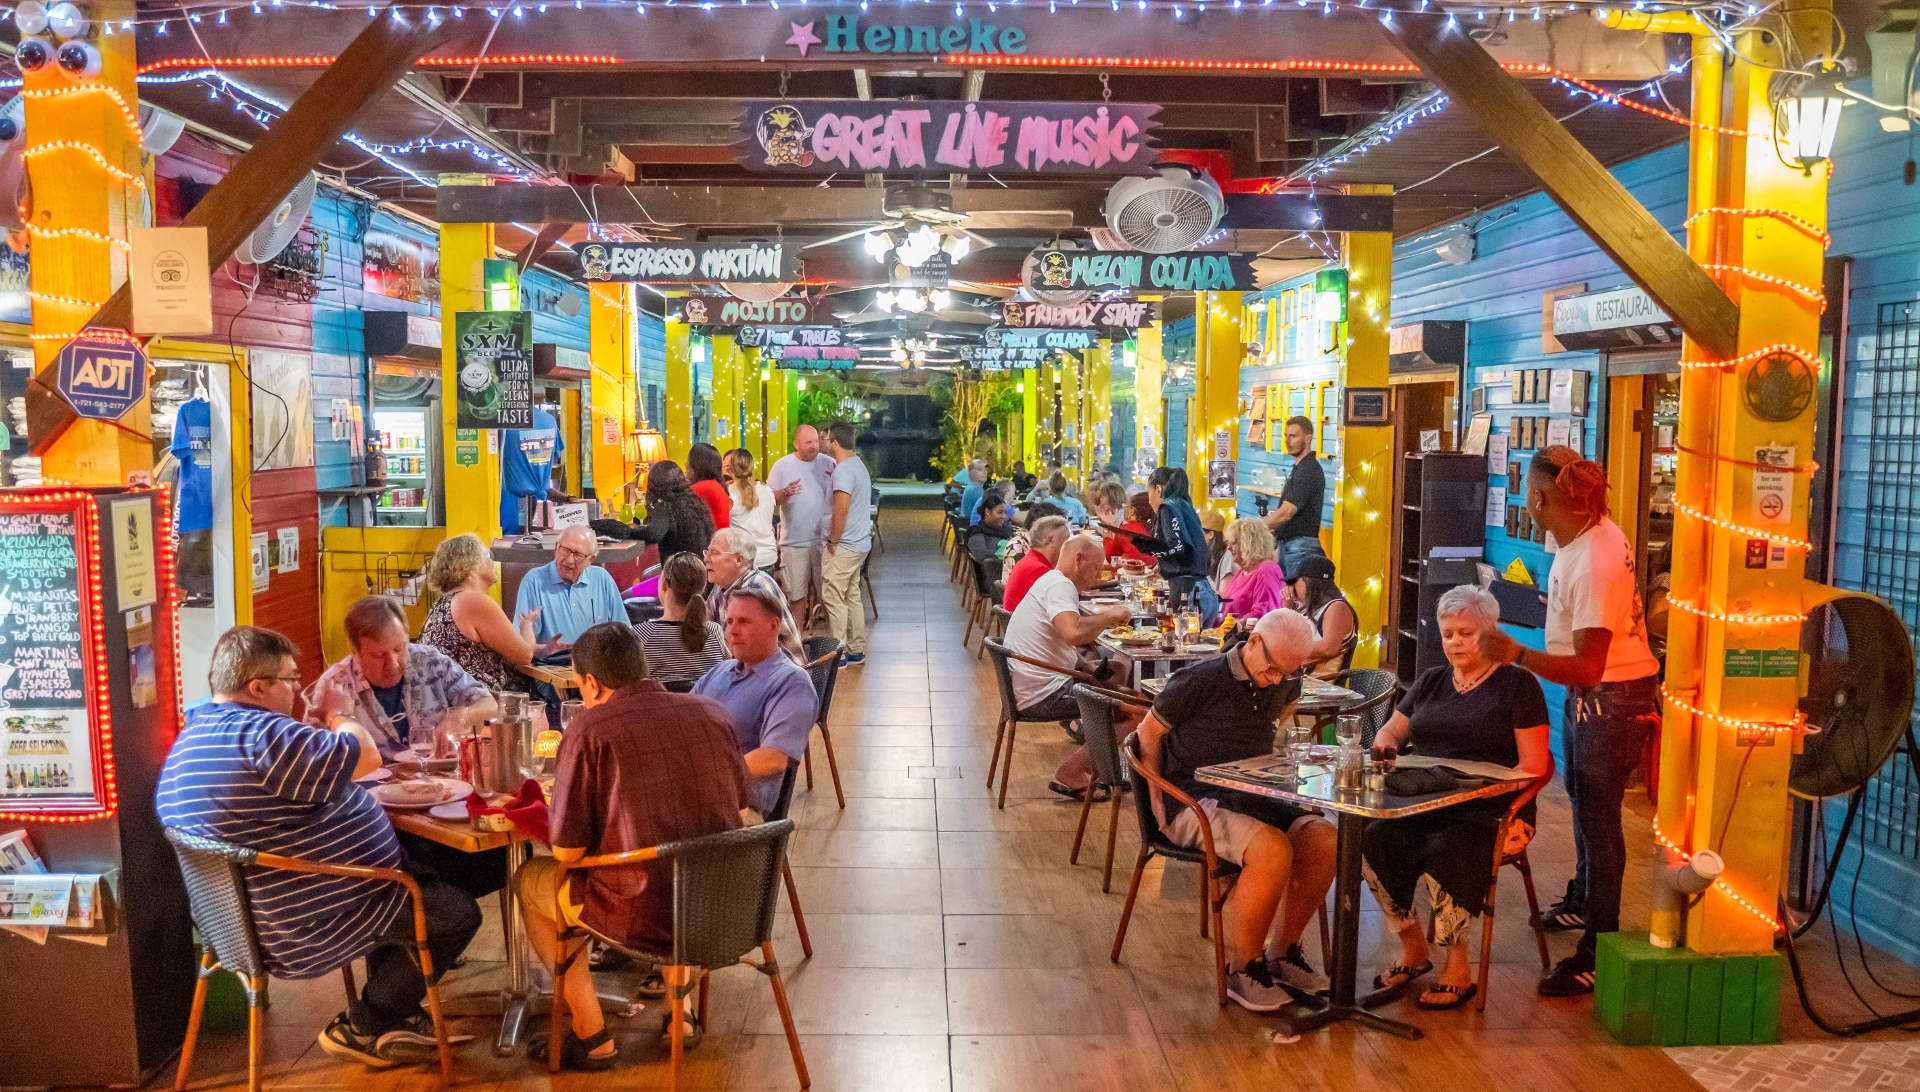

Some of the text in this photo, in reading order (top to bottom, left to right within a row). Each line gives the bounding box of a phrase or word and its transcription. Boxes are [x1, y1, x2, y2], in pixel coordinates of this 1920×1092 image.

[826, 14, 1026, 54] Heineke
[812, 108, 931, 169] GREAT
[1015, 106, 1139, 171] MUSIC
[611, 243, 783, 280] ESPRESSO MARTINI
[1072, 255, 1236, 290] MELON COLADA
[721, 302, 807, 322] MOJITO
[1024, 302, 1148, 328] FRIENDLY STAFF
[1596, 296, 1660, 321] RESTAURAN
[462, 334, 516, 350] SXM
[1045, 332, 1090, 348] COLADA
[501, 360, 528, 372] ULTRA
[72, 357, 134, 390] ADT
[508, 381, 529, 389] FOR A
[503, 391, 529, 400] CLEAN
[496, 410, 529, 423] TASTE
[6, 567, 67, 579] SMOOTHIES
[11, 589, 79, 602] MARGARITAS
[43, 601, 72, 612] PETE
[15, 612, 79, 624] STRAWBERRY
[27, 623, 70, 632] MANGO
[59, 632, 81, 642] GOLD
[20, 679, 72, 690] ESPRESSO
